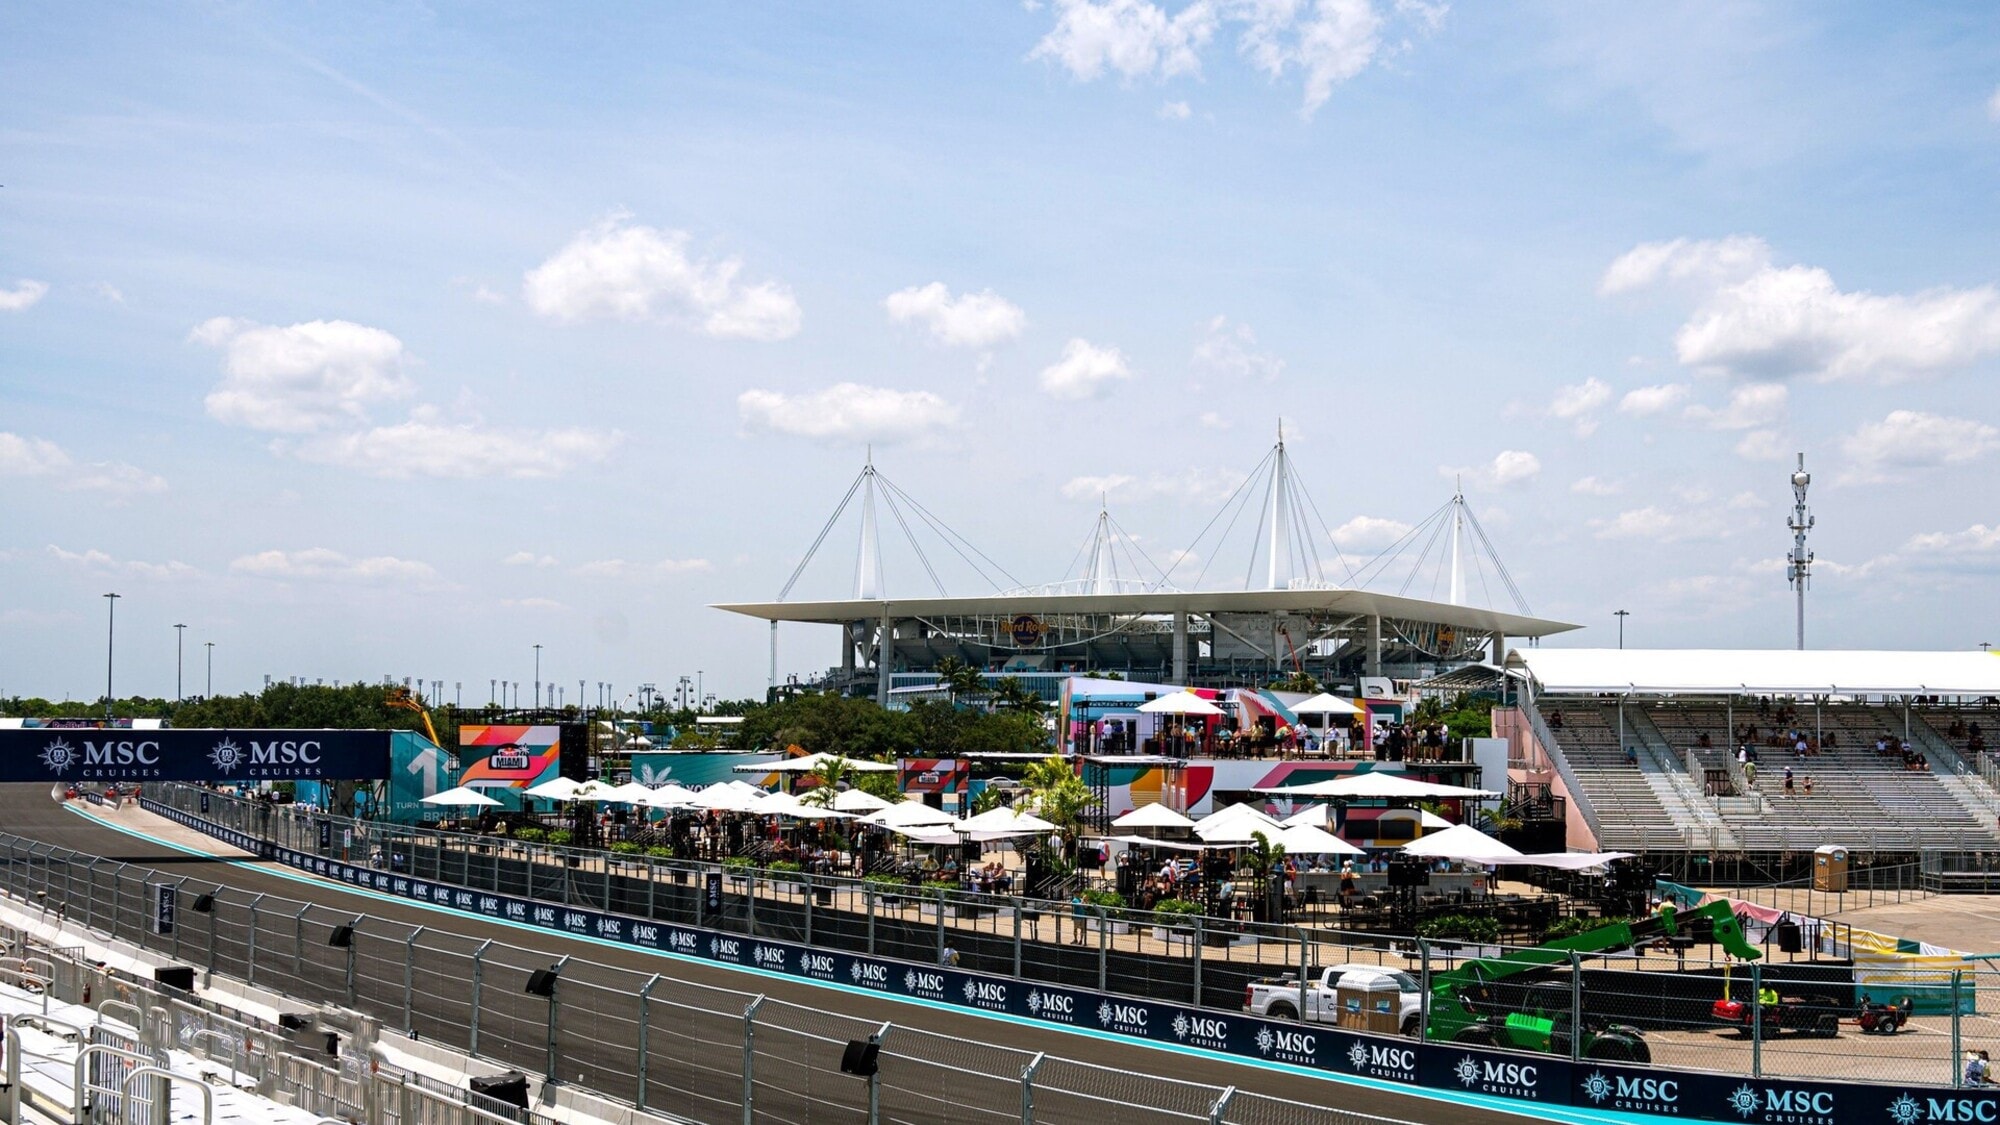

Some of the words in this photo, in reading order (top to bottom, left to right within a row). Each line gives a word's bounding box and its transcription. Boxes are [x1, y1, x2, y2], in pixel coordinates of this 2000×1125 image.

[83, 741, 160, 765] MSC
[249, 741, 321, 764] MSC
[496, 757, 522, 768] MIAMI
[83, 769, 160, 777] CRUISES
[249, 768, 321, 776] CRUISES
[416, 884, 427, 897] MSC
[437, 888, 449, 900] MSC
[709, 880, 717, 898] MSC
[461, 893, 472, 905] MSC
[484, 898, 497, 910] MSC
[512, 903, 525, 917] MSC
[539, 908, 554, 921] MSC
[571, 914, 586, 929] MSC
[605, 920, 620, 933] MSC
[640, 926, 657, 940] MSC
[679, 932, 696, 947] MSC
[720, 939, 739, 956] MSC
[764, 947, 784, 964] MSC
[812, 955, 833, 973] MSC
[811, 971, 834, 979] CRUISES
[863, 964, 886, 982] MSC
[862, 980, 887, 990] CRUISES
[918, 973, 943, 992] MSC
[918, 990, 944, 999] CRUISES
[978, 983, 1005, 1002] MSC
[977, 1000, 1006, 1010] CRUISES
[1043, 993, 1072, 1014] MSC
[1042, 1012, 1073, 1022] CRUISES
[1114, 1005, 1147, 1027] MSC
[1114, 1024, 1147, 1035] CRUISES
[1191, 1017, 1226, 1041] MSC
[1191, 1038, 1226, 1049] CRUISES
[1276, 1031, 1315, 1055] MSC
[1276, 1052, 1316, 1064] CRUISES
[1371, 1046, 1414, 1071] MSC
[1370, 1068, 1414, 1080] CRUISES
[1483, 1061, 1536, 1087] MSC
[1483, 1084, 1536, 1097] CRUISES
[1616, 1076, 1677, 1102] MSC
[1616, 1100, 1678, 1113] CRUISES
[1766, 1089, 1832, 1114] MSC
[1927, 1098, 1996, 1122] MSC
[1766, 1114, 1833, 1125] CRUISES
